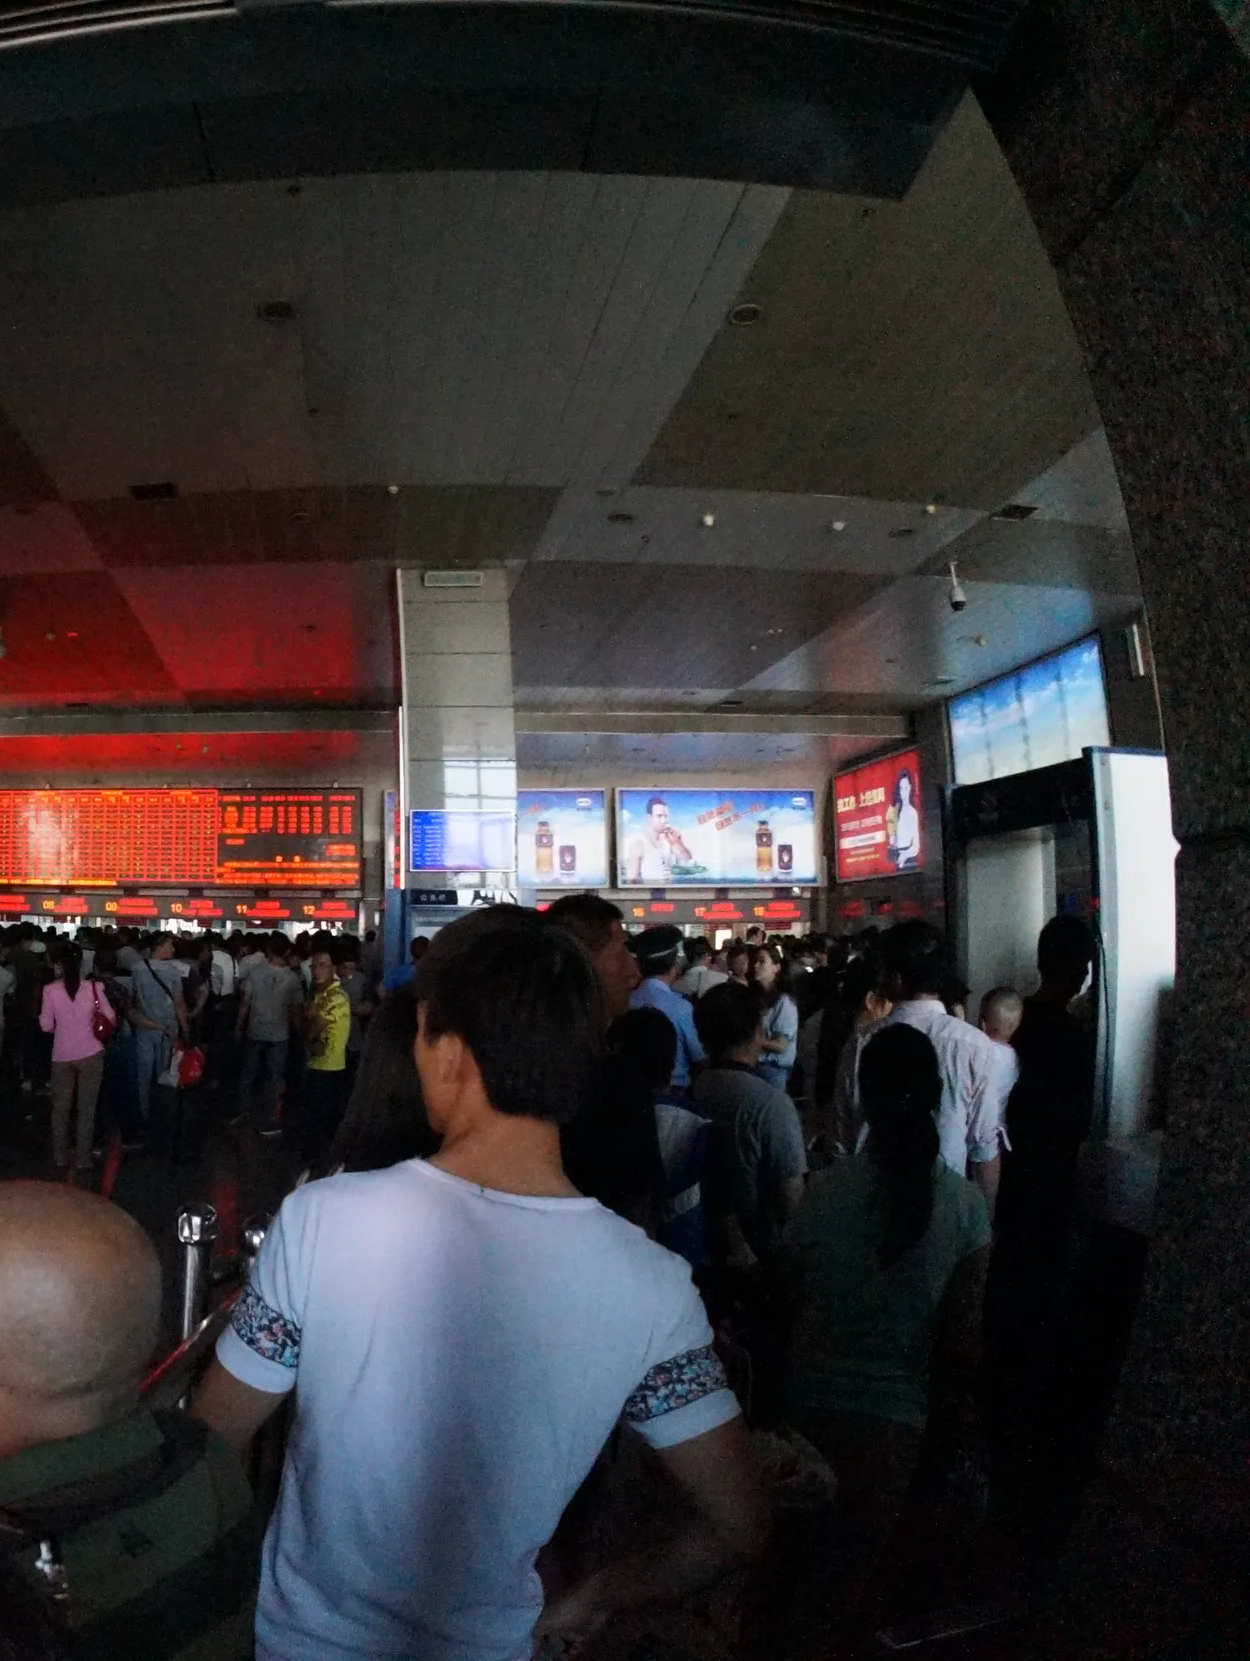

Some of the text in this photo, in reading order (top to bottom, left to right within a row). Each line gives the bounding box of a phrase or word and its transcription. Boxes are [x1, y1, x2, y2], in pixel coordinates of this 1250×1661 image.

[106, 902, 117, 911] 09
[170, 904, 182, 913] 10
[236, 905, 247, 914] 11
[303, 905, 315, 914] 12
